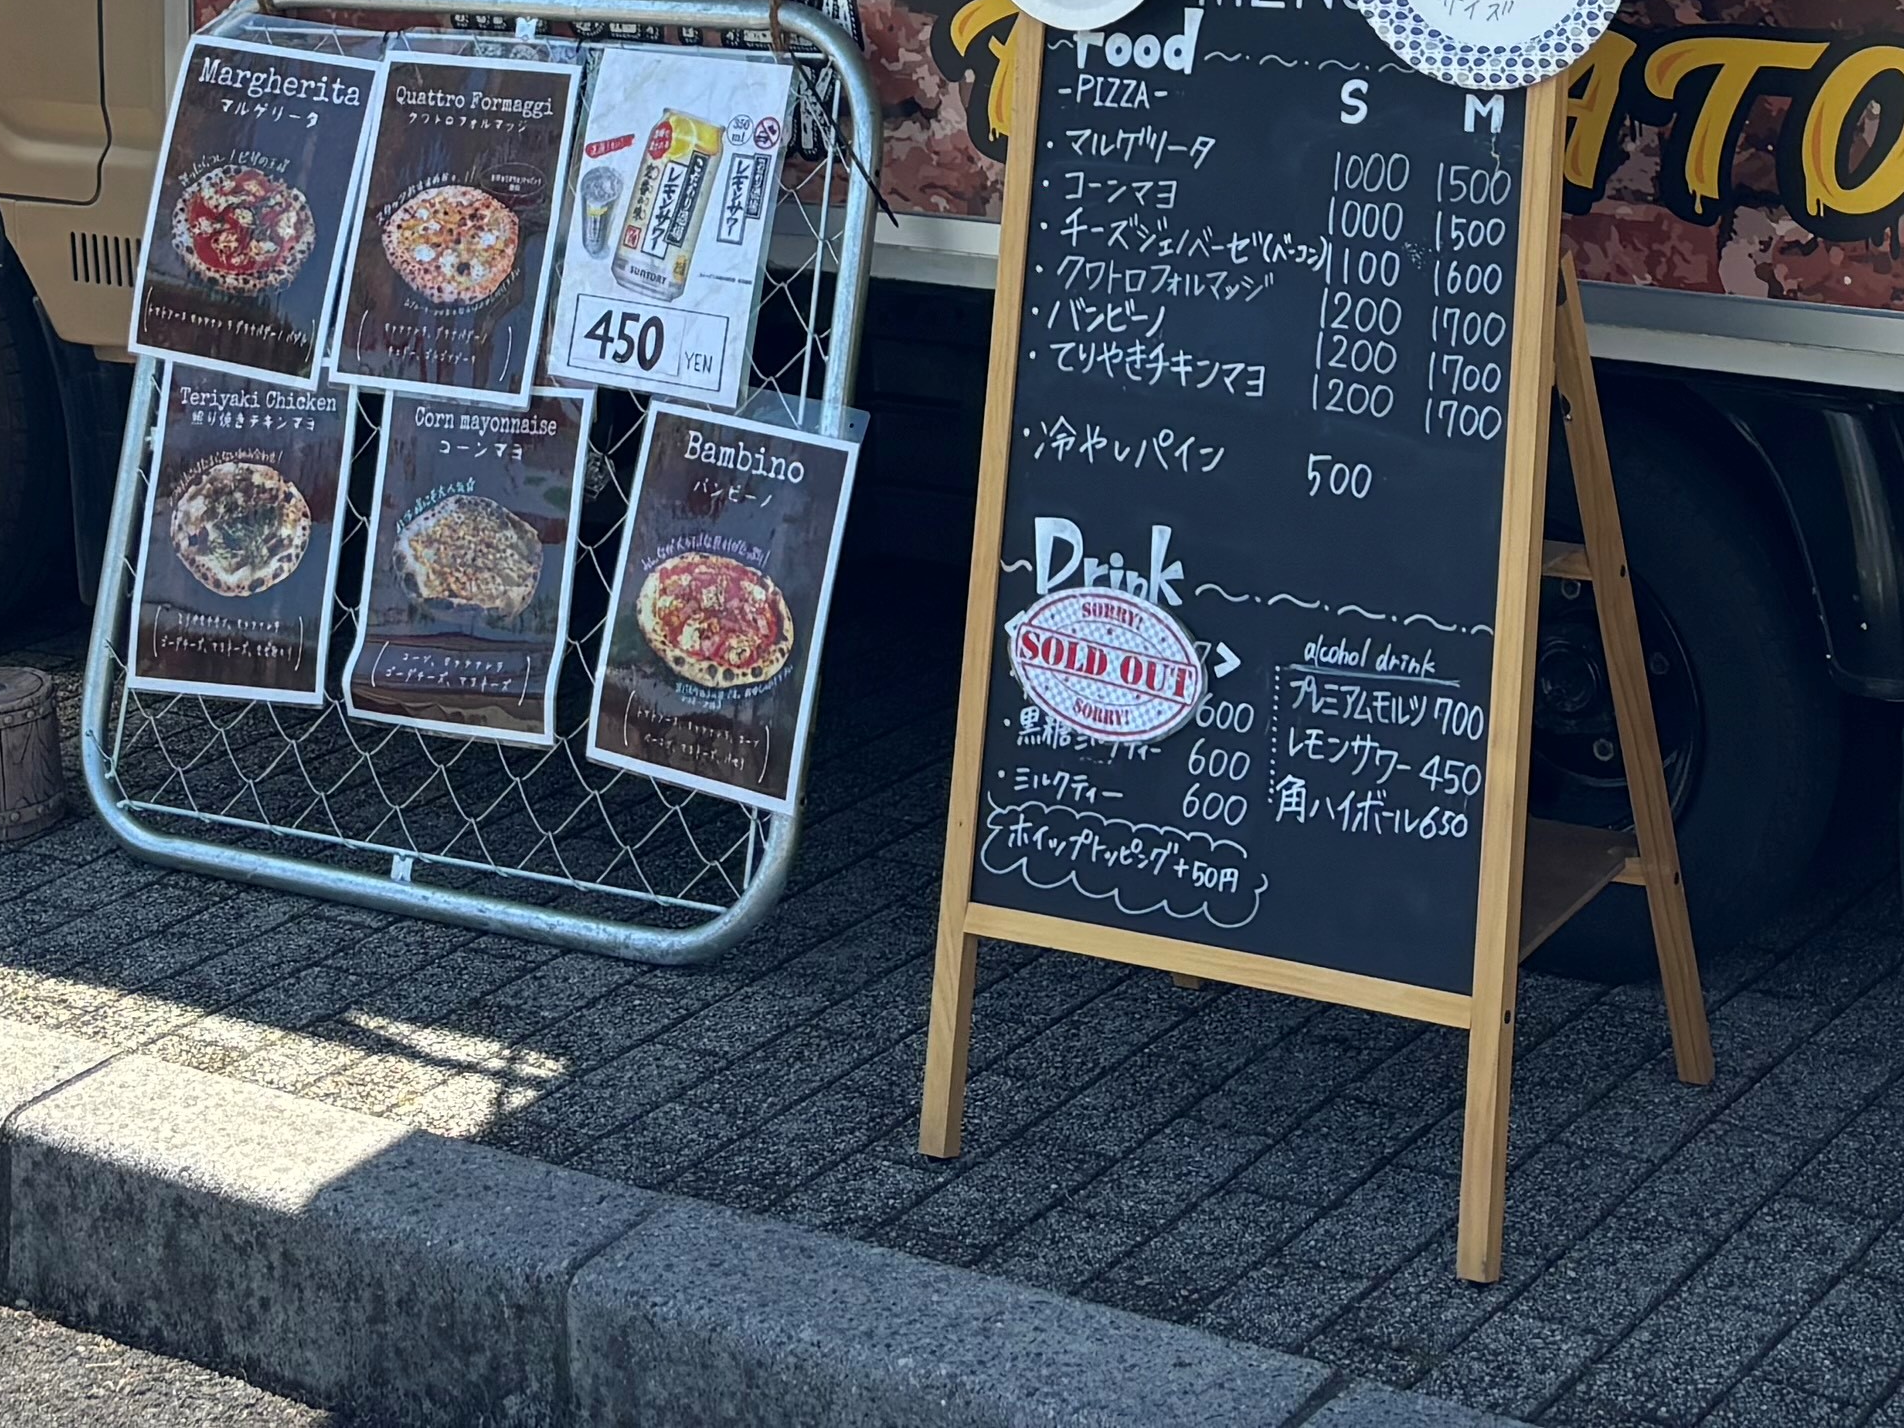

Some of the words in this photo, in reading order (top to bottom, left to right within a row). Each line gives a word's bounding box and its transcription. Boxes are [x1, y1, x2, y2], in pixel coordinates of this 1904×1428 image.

[1073, 7, 1205, 75] Food
[198, 57, 361, 107] Margherita
[395, 86, 466, 109] Quattro
[470, 91, 554, 119] Formaggi
[1339, 79, 1369, 126] S
[1463, 93, 1505, 135] M
[221, 99, 320, 129] マルゲリータ
[732, 118, 750, 131] 350
[1064, 122, 1217, 170] マルゲリータ
[1332, 150, 1411, 195] 1000
[1435, 161, 1513, 207] 1500
[1063, 169, 1179, 211] コーンマヨ
[1328, 199, 1404, 241] 1000
[1433, 210, 1507, 251] 1500
[1323, 240, 1401, 289] 1100
[1432, 260, 1504, 296] 1600
[1055, 252, 1276, 304] クワトロフォルマッジ
[1319, 286, 1403, 336] 1200
[1430, 305, 1507, 347] 1700
[584, 309, 665, 372] 450
[684, 351, 714, 374] YEN
[1046, 295, 1168, 341] バンビーノ
[1314, 334, 1398, 376] 1200
[1426, 352, 1502, 396] 1700
[180, 386, 261, 412] Teriyaki
[265, 390, 337, 412] Chicken
[1048, 343, 1266, 398] てりやきチキンマヨ
[1311, 374, 1395, 418] 1200
[1423, 395, 1503, 442] 1700
[415, 406, 454, 429] Corn
[459, 414, 558, 437] mayonnaise
[439, 440, 524, 461] コーンマヨ
[684, 430, 805, 483] Bambino
[1033, 415, 1226, 473] 冷やしパイン
[1306, 453, 1373, 500] 500
[693, 478, 773, 508] バンビーノ
[1033, 515, 1185, 607] Drink
[1081, 601, 1144, 632] SORRY!
[1018, 630, 1108, 677] SOLD
[1119, 655, 1194, 699] OUT
[1304, 637, 1371, 670] alcohol
[1375, 650, 1437, 677] drink
[1072, 696, 1131, 726] SORRY!
[1197, 692, 1255, 733] 600
[1288, 678, 1428, 726] プレミアムモルツ
[1433, 700, 1485, 741] 700
[1187, 737, 1251, 781] 600
[1287, 724, 1412, 786] レモンサワー
[1419, 757, 1482, 797] 450
[1012, 766, 1125, 804] ミルクティー
[1182, 784, 1248, 828] 600
[1274, 773, 1419, 836] 角ハイボール
[1418, 806, 1469, 840] 650
